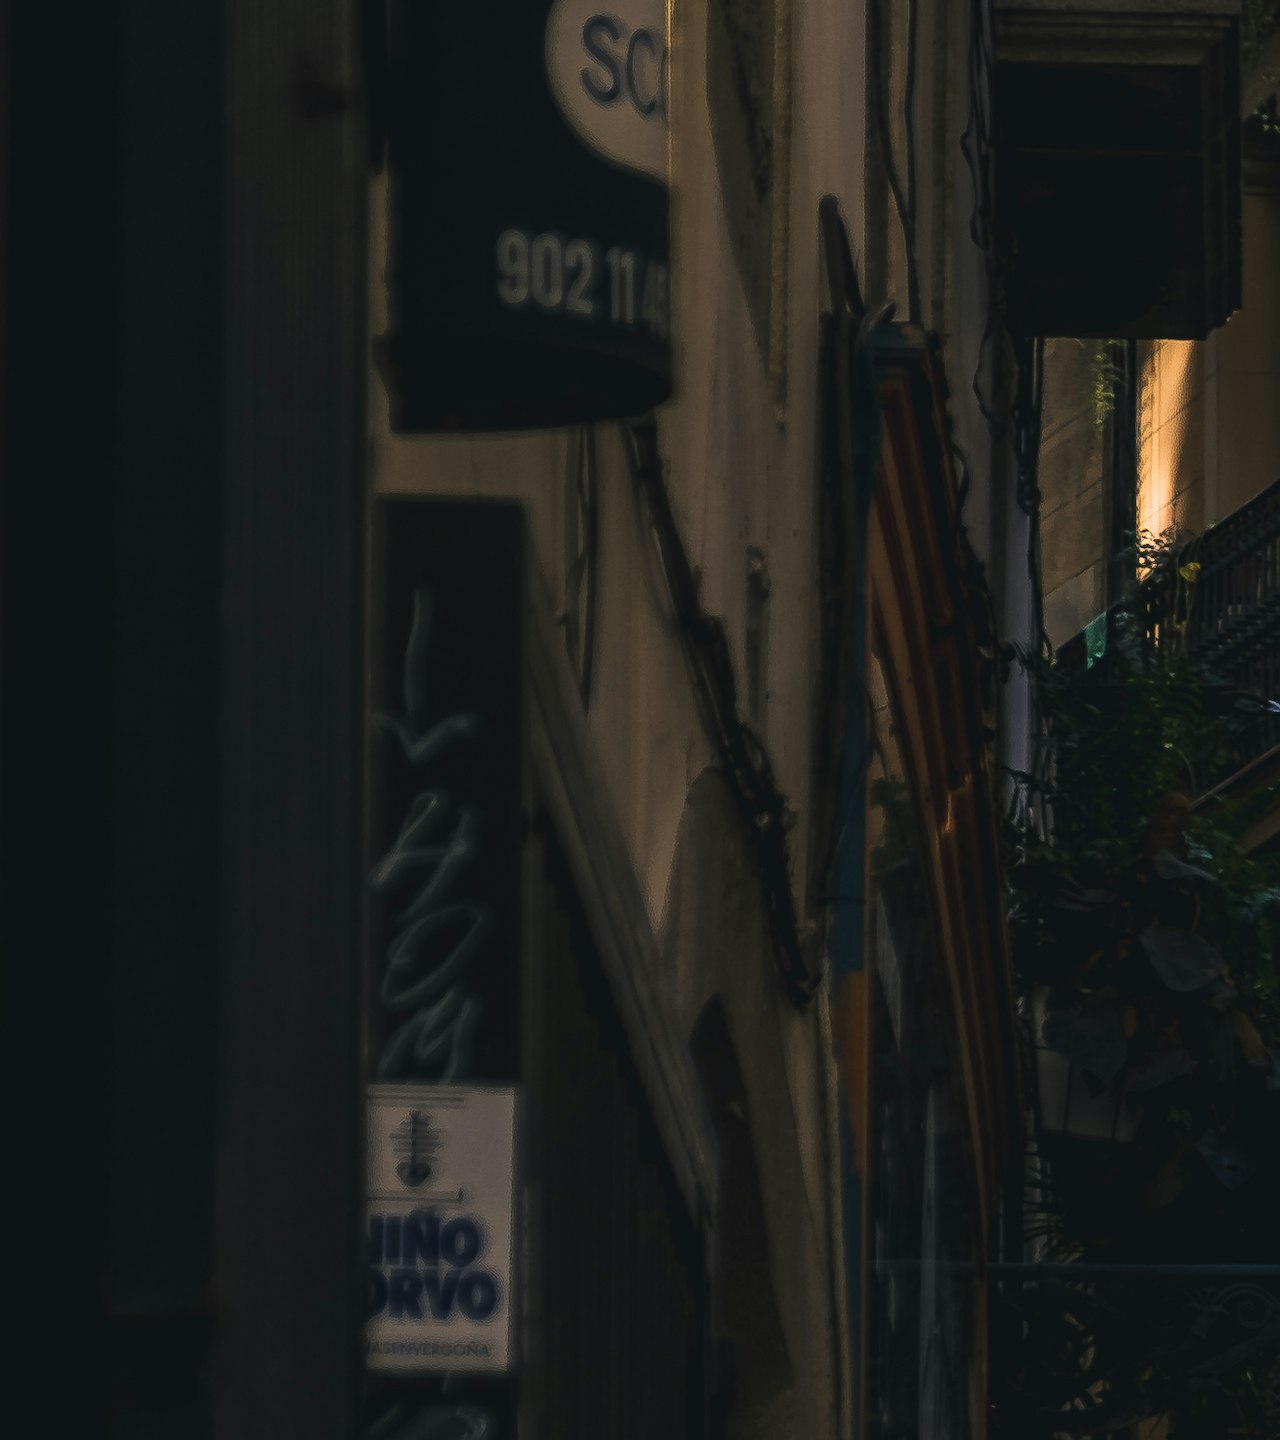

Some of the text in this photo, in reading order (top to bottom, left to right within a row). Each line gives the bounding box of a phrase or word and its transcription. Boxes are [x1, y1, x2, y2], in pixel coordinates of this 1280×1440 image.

[580, 13, 667, 117] SC
[496, 226, 594, 315] 902
[605, 245, 637, 327] 11
